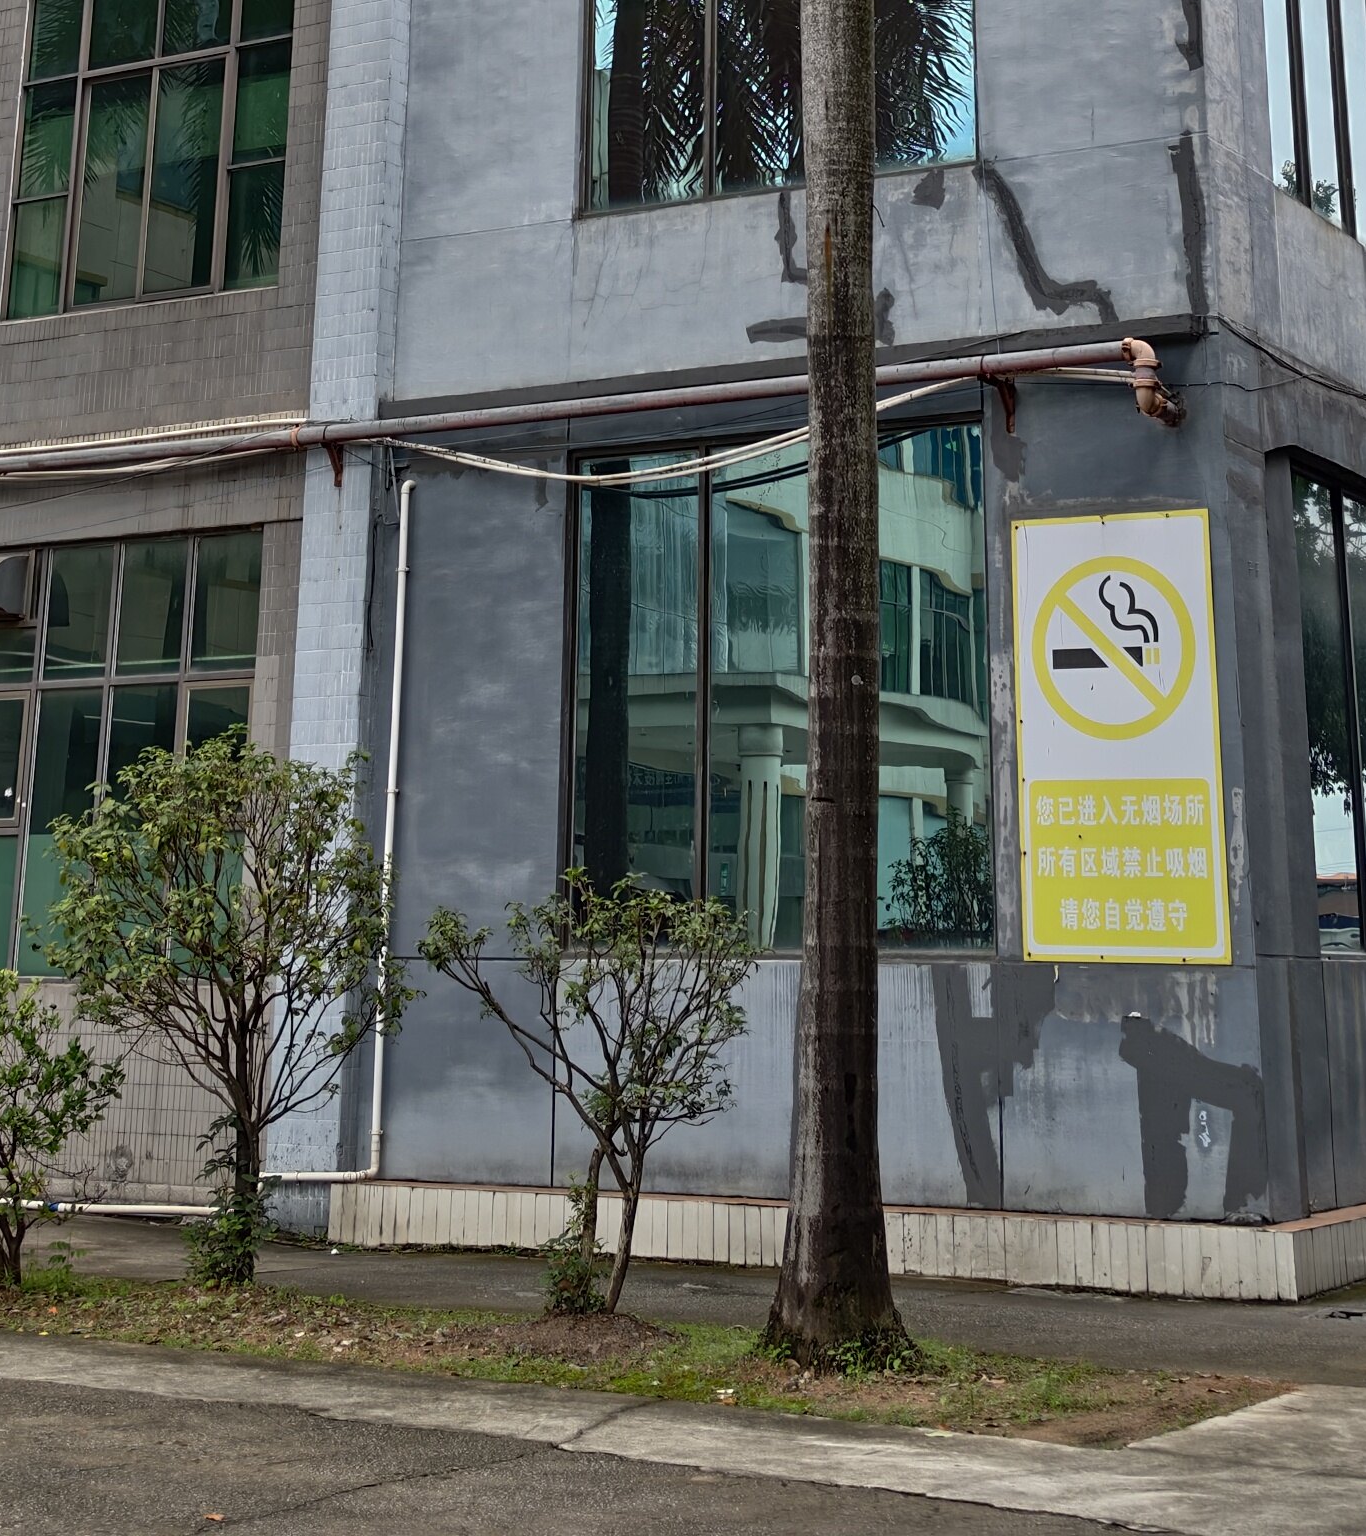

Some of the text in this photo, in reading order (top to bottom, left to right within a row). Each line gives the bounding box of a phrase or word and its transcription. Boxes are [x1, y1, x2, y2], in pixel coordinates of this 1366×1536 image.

[1035, 794, 1205, 826] 您已进入无烟场所
[1036, 846, 1209, 879] 所有区域禁止吸烟
[1059, 897, 1188, 932] 请您自觉遵守
